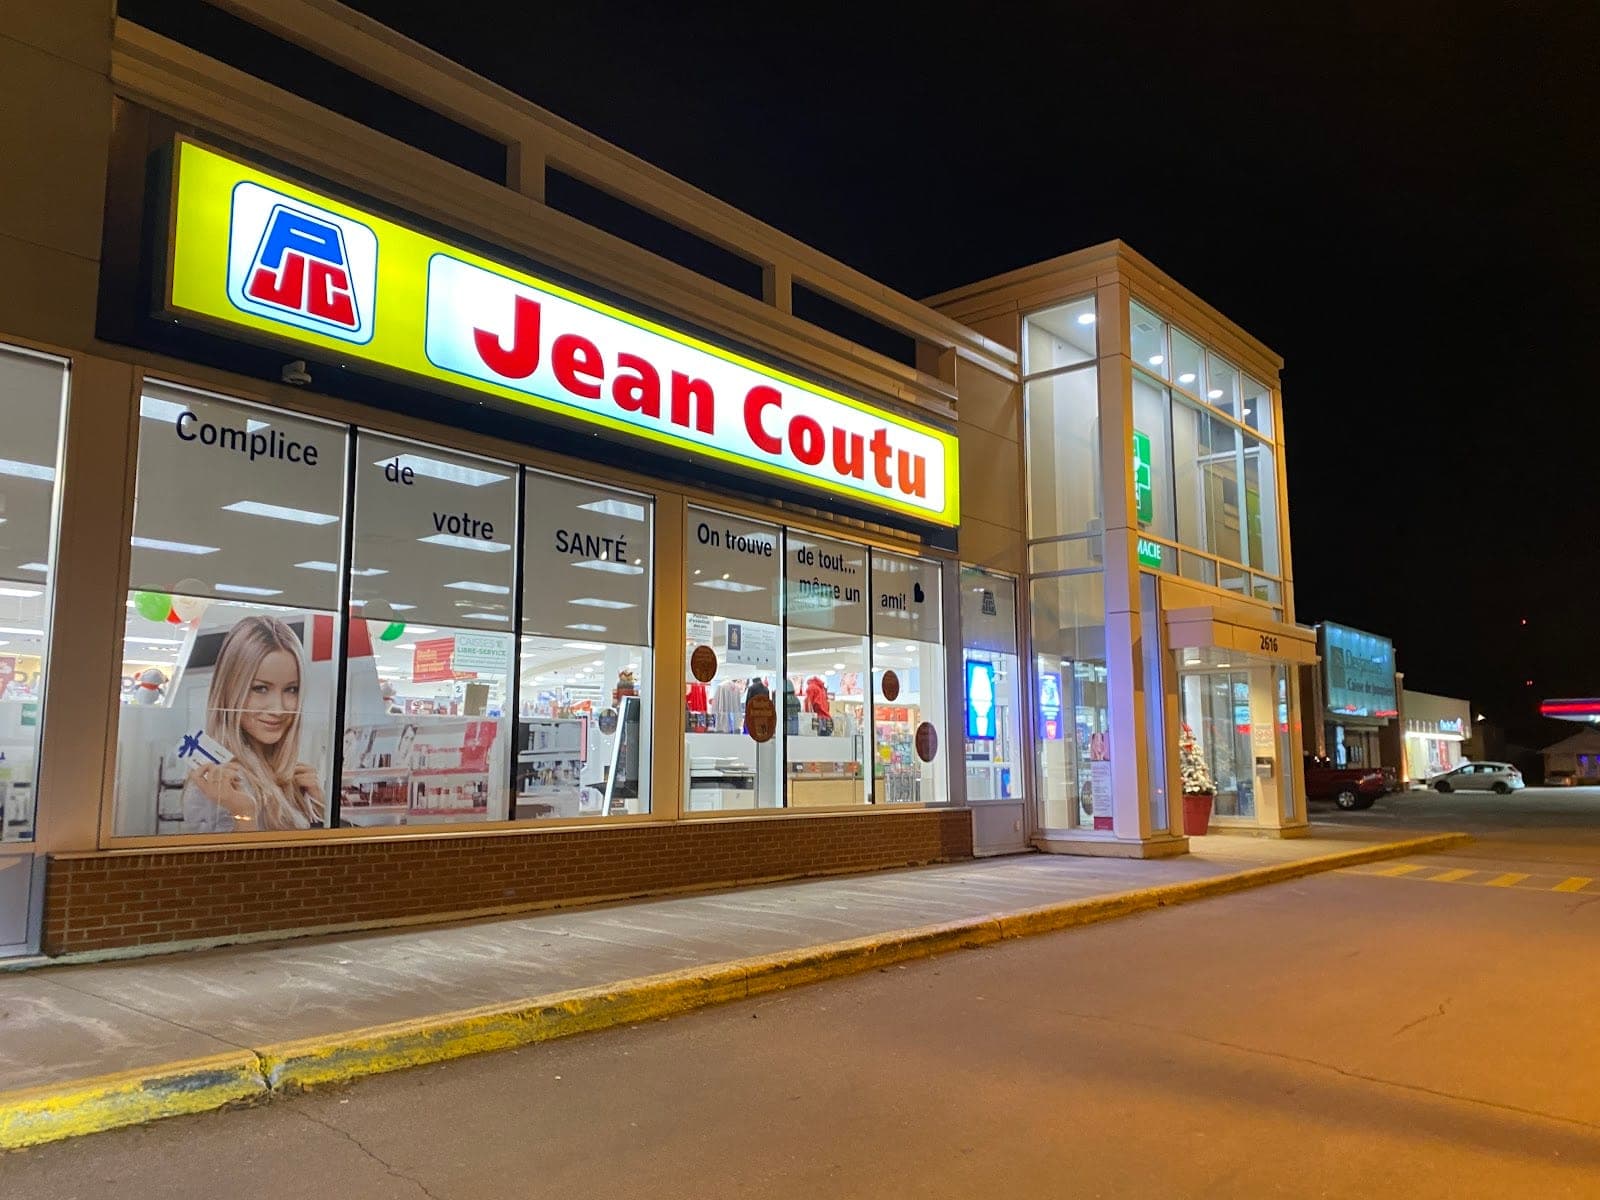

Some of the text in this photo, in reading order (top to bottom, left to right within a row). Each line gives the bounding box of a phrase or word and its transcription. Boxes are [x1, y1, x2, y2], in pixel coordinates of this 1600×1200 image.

[473, 294, 926, 498] Jean Coutu
[175, 410, 319, 467] Complice
[384, 457, 415, 486] de
[432, 511, 495, 541] votre
[696, 523, 773, 558] On trouve
[555, 529, 628, 563] SANTÉ
[797, 545, 856, 574] de tout...
[799, 577, 861, 602] même un
[880, 590, 907, 611] ami!
[457, 647, 507, 657] LIBRE-SERVICE
[1259, 635, 1279, 652] 2616
